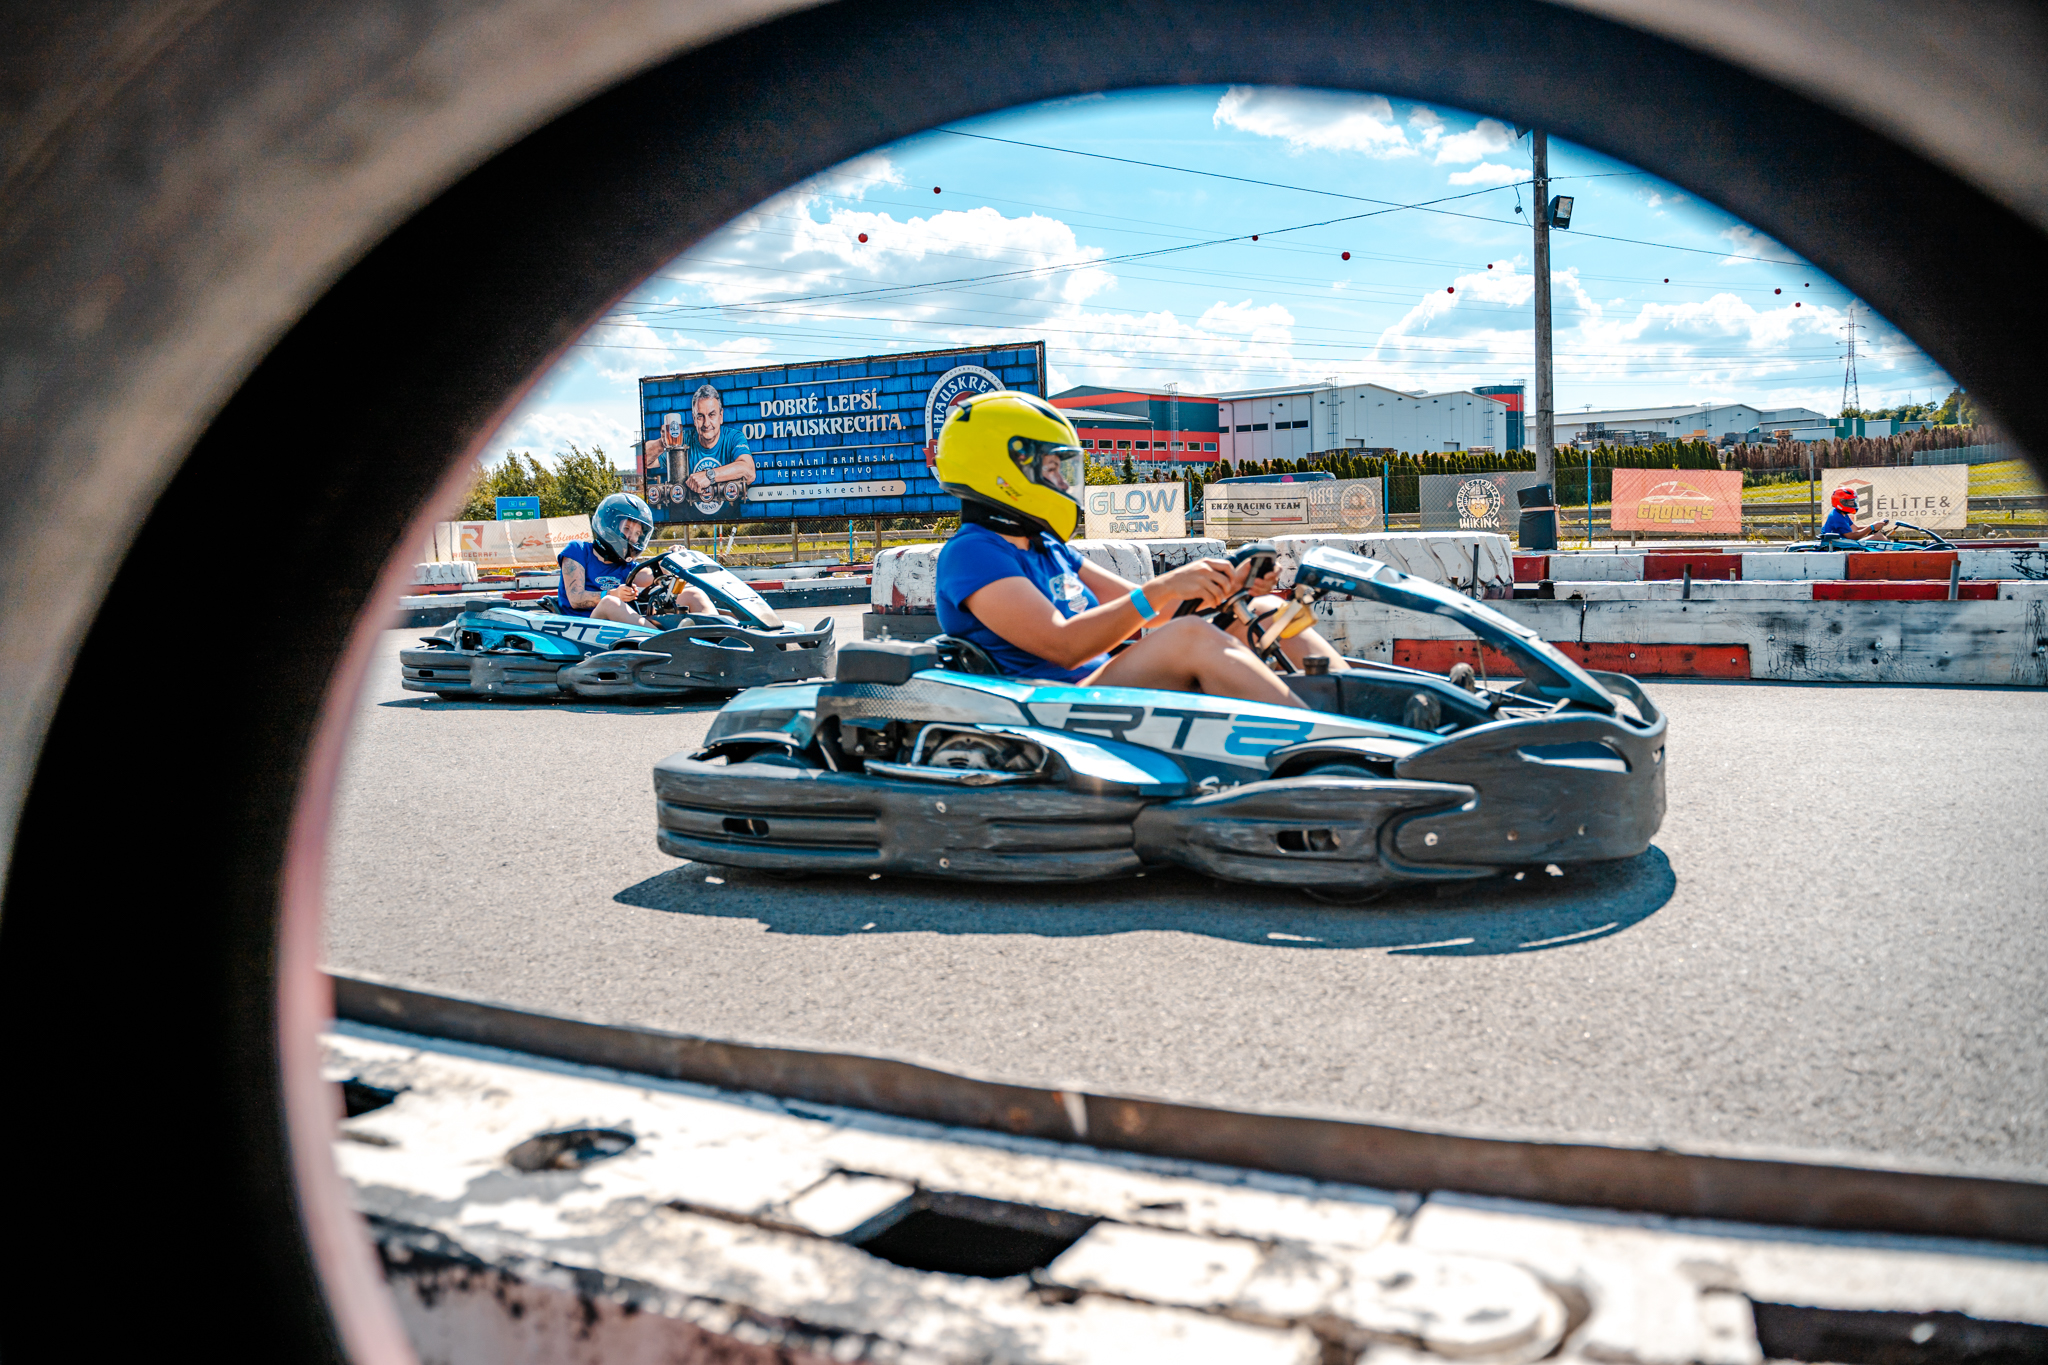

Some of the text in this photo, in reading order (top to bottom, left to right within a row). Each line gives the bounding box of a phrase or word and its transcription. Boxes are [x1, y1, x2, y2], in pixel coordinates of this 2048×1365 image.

[760, 388, 882, 418] DOBRÉ, LEPŠÍ,
[742, 413, 907, 440] OD HAUSKRECHTA.
[843, 466, 872, 475] PIVO
[757, 485, 895, 497] www.hauskrecht.cz
[1089, 489, 1177, 515] GLOW
[1236, 502, 1272, 516] RACING
[1274, 502, 1300, 510] TEAM
[1877, 509, 1927, 519] espacio
[1109, 521, 1159, 533] RACING
[1459, 517, 1500, 529] WIKING
